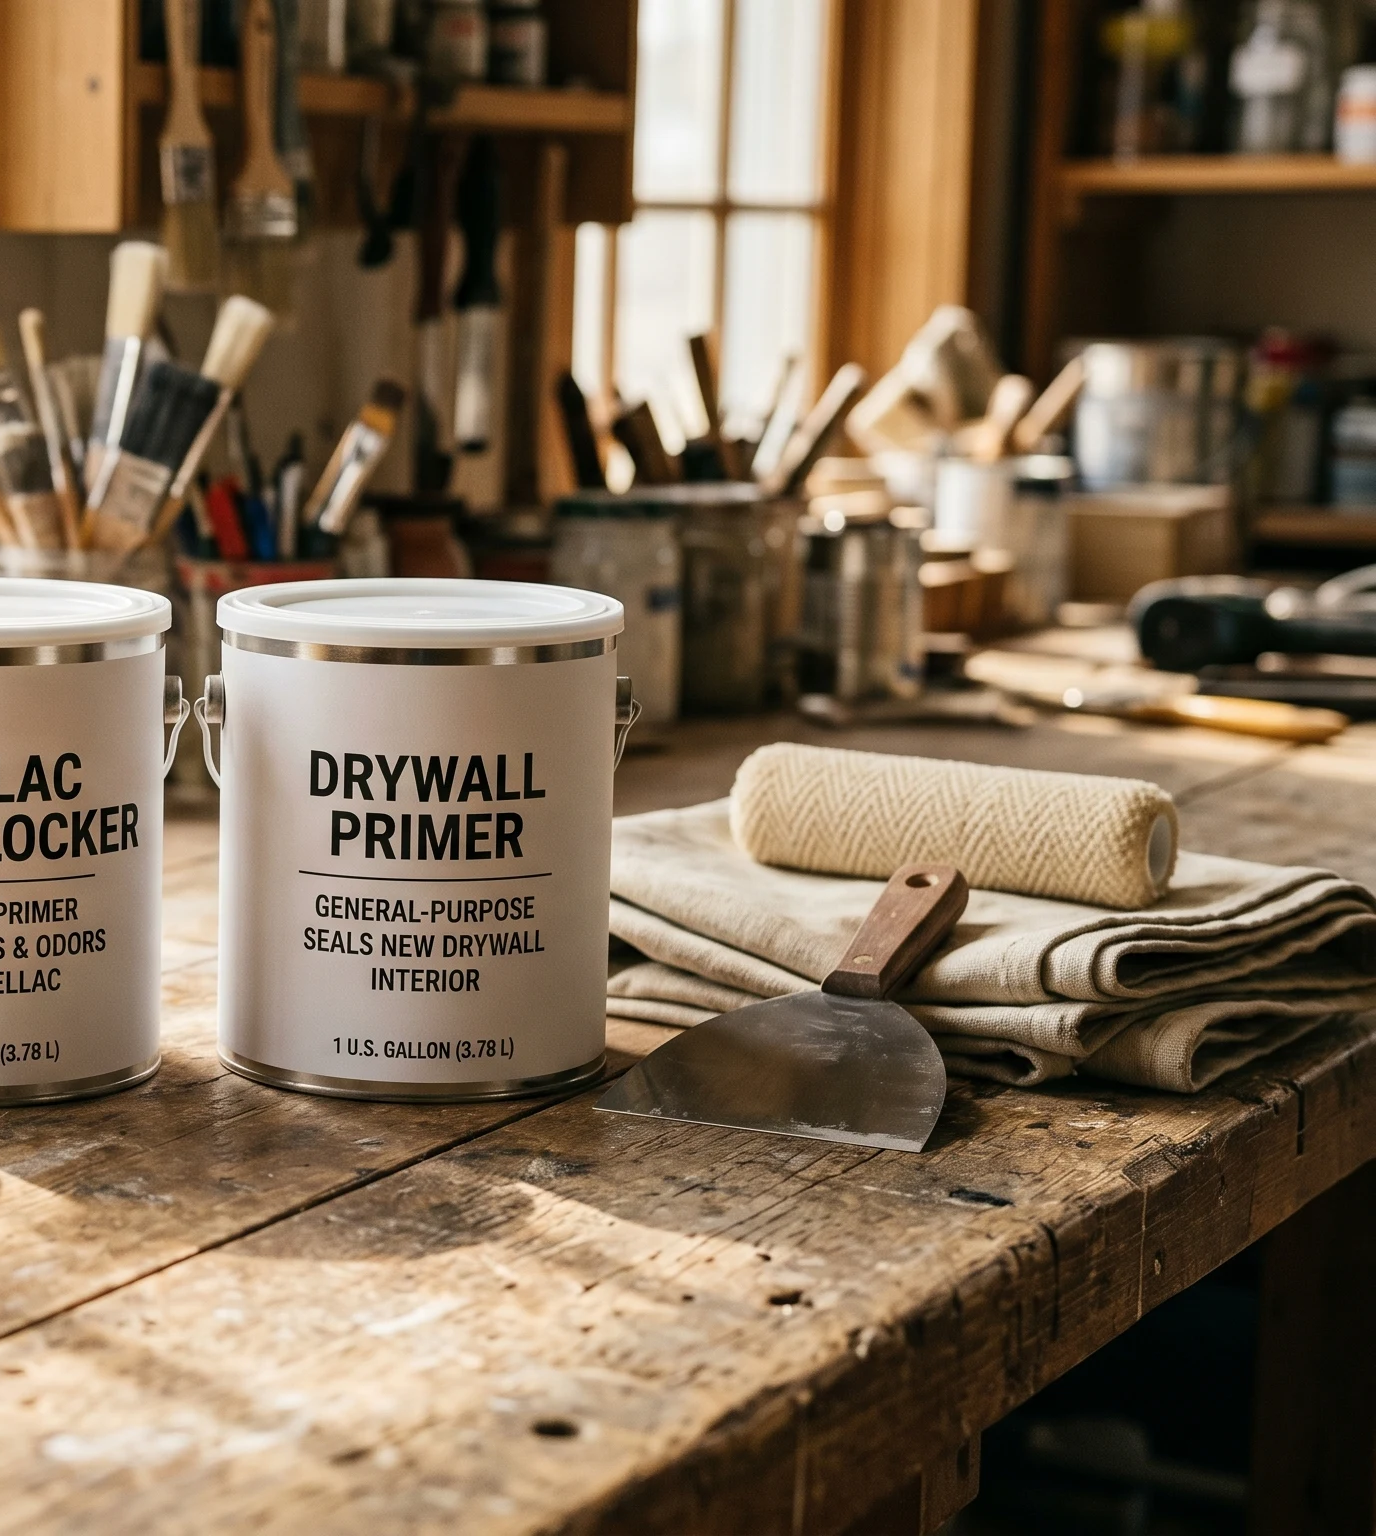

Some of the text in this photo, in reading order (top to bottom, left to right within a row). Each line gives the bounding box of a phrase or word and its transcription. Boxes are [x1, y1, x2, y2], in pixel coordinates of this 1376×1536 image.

[310, 750, 546, 803] DRYWALL
[331, 810, 524, 861] PRIMER
[315, 894, 535, 923] GENERAL-PURPOSE
[13, 936, 29, 960] &
[36, 929, 106, 957] ODORS
[303, 927, 545, 957] SEALS NEW DRYWALL
[371, 968, 480, 992] INTERIOR
[0, 1042, 41, 1066] (3.78
[45, 1040, 60, 1062] L)
[333, 1037, 515, 1062] 1 U.S. GALLON (3.78 L)
